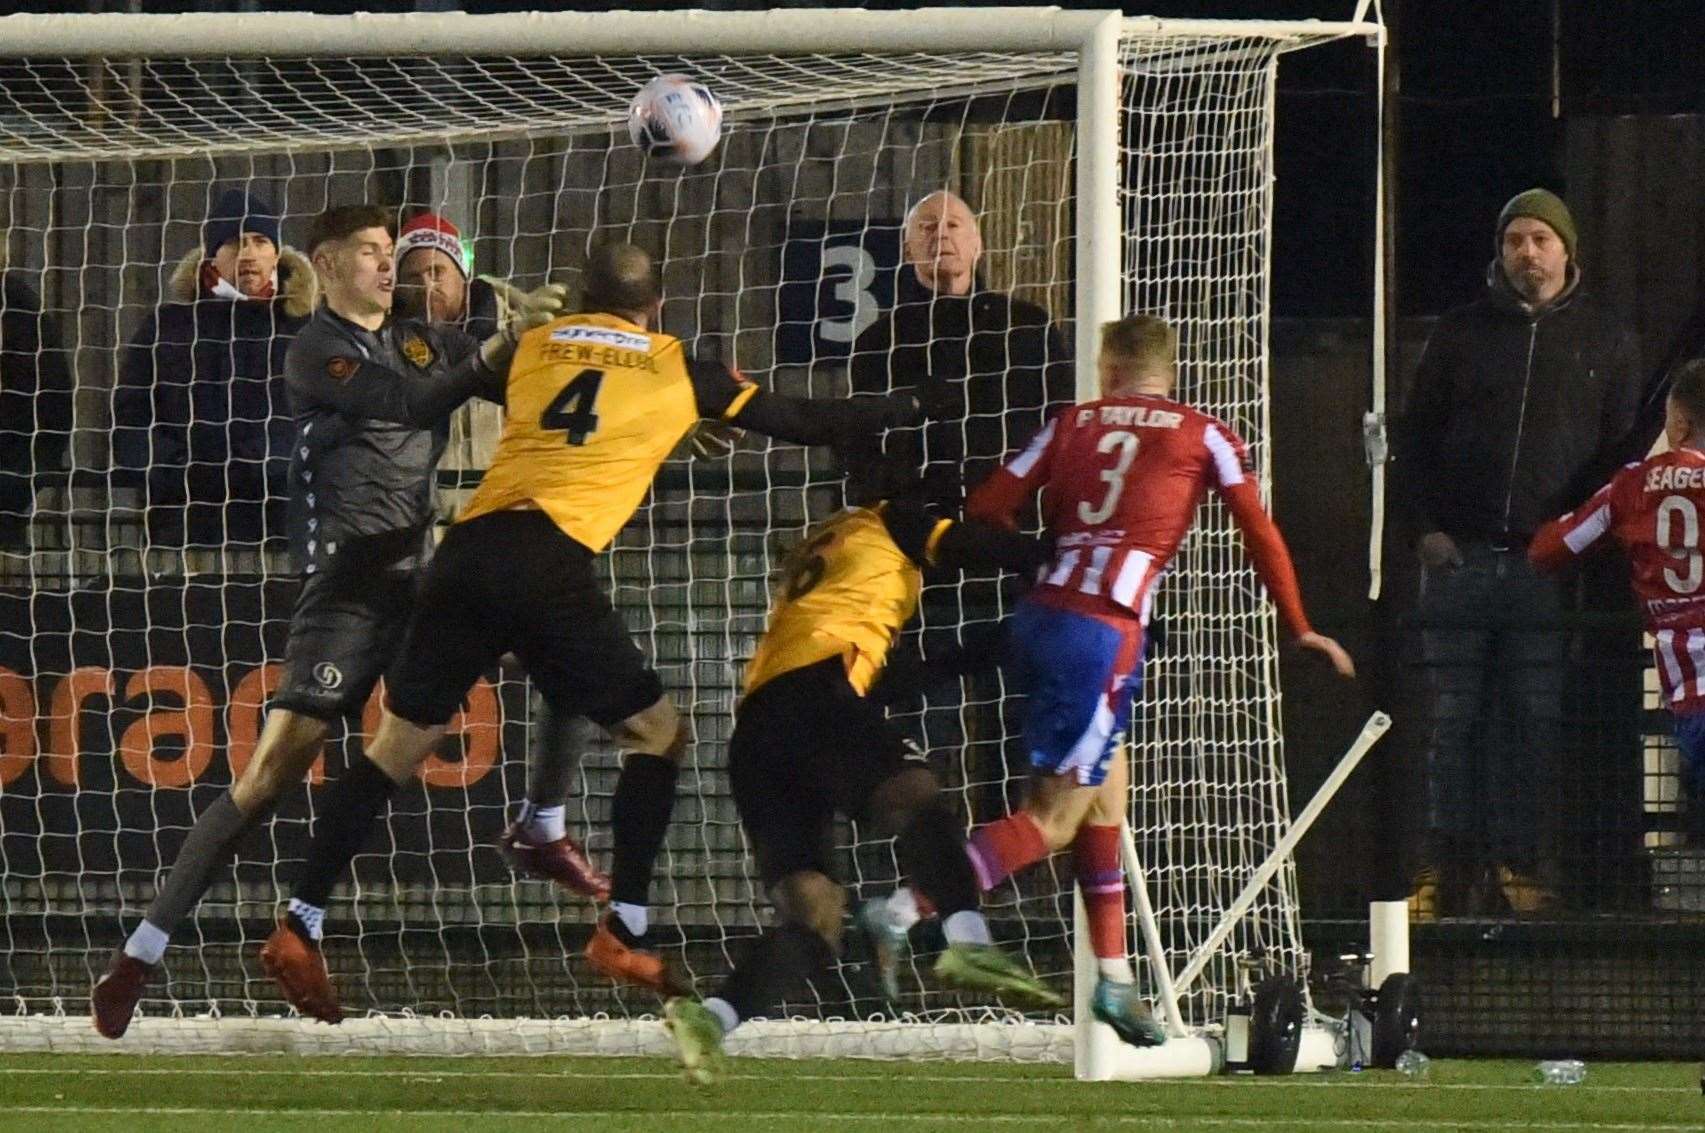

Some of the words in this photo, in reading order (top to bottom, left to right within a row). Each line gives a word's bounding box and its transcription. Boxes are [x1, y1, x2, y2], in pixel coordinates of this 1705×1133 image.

[819, 245, 879, 343] 3
[540, 368, 605, 446] 4
[1076, 409, 1095, 428] P
[1099, 405, 1185, 430] TAYLOR
[1077, 430, 1140, 525] 3
[1656, 494, 1704, 594] 9
